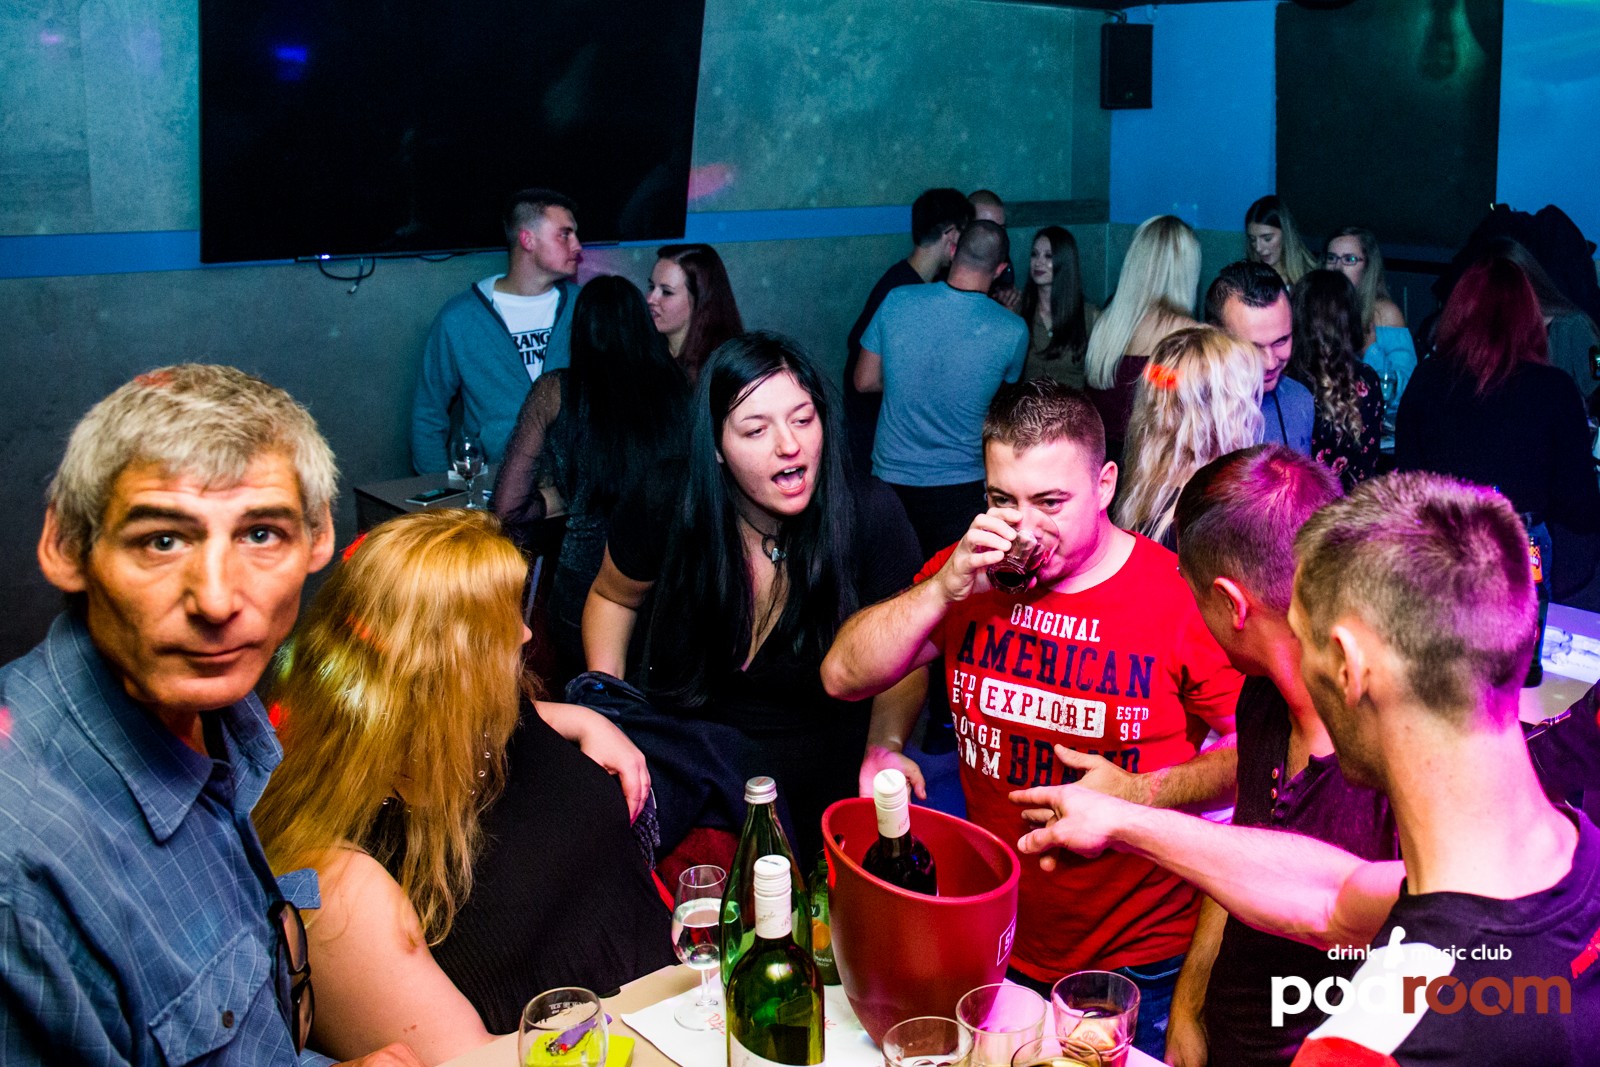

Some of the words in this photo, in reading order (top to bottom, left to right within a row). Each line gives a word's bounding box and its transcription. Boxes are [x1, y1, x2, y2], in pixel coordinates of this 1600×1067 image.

[1010, 603, 1101, 643] ORIGINAL
[957, 620, 1156, 699] AMERICAN
[953, 669, 977, 691] LTD
[952, 687, 974, 710] ET
[985, 685, 1097, 731] EXPLORE
[1116, 705, 1149, 721] ESTD
[1119, 722, 1141, 742] 99
